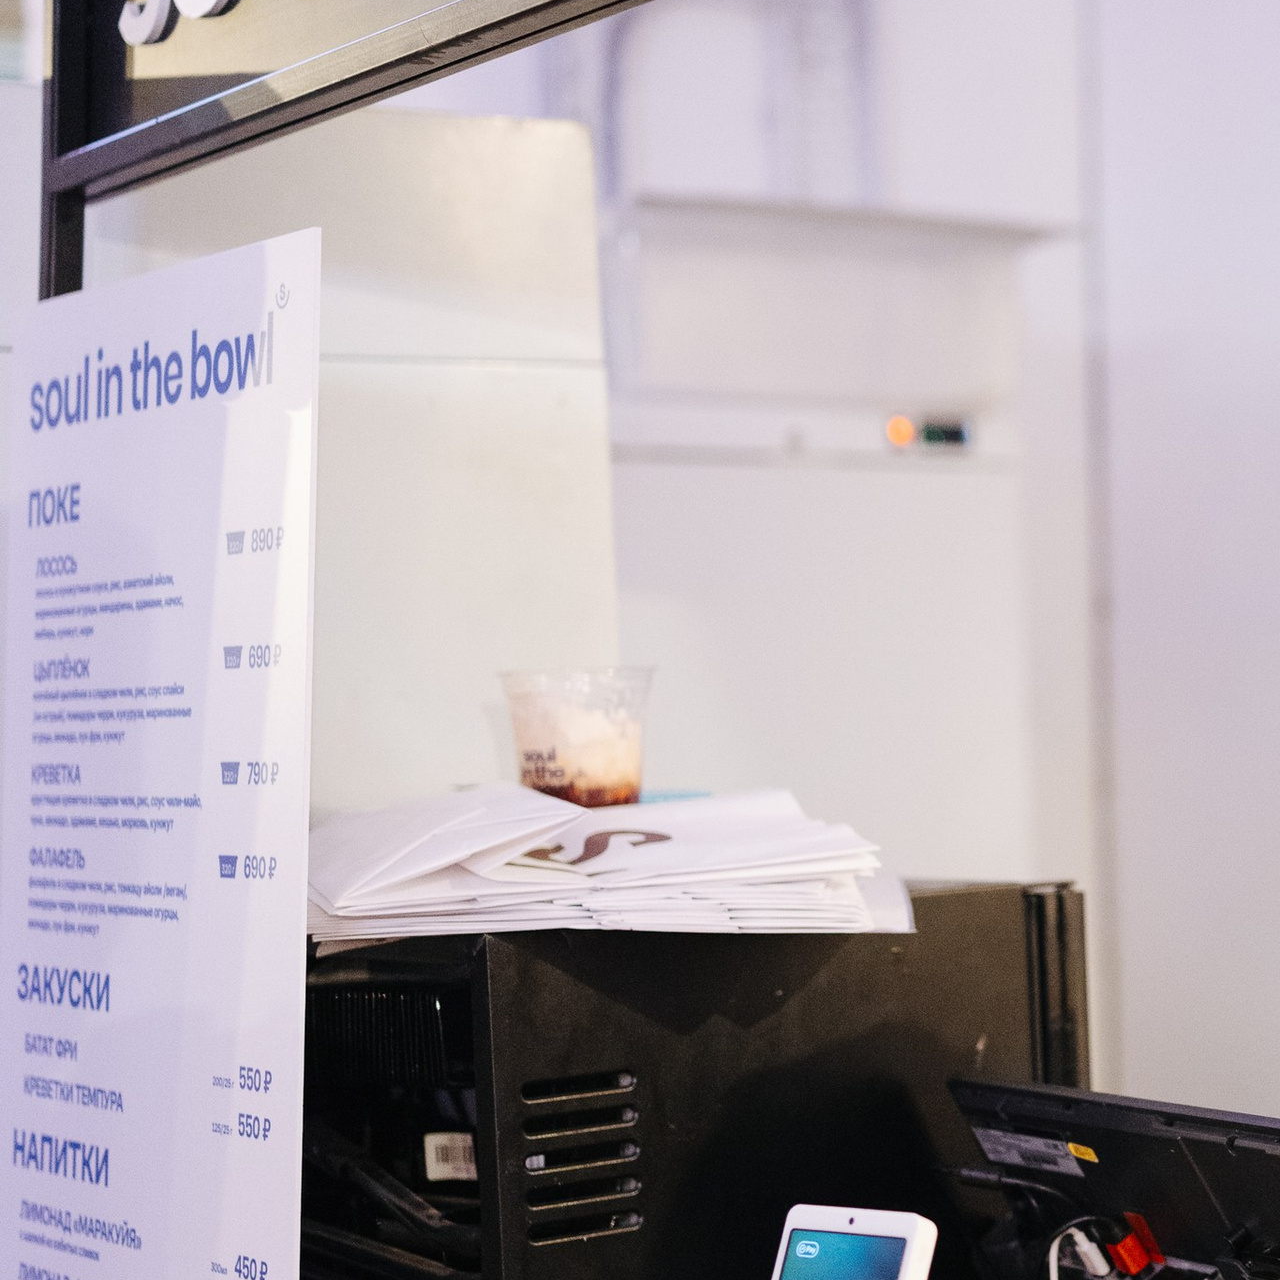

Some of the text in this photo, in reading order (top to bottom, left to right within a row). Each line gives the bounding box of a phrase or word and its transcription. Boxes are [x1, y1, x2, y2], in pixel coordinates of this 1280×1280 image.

[30, 311, 274, 432] soul in the bowl
[28, 483, 81, 528] ПОКЕ
[250, 528, 274, 552] 890
[35, 556, 78, 577] ЛОСОСЬ
[33, 654, 90, 682] ЦЫПЛЁНОК
[248, 645, 271, 669] 690
[31, 763, 81, 785] КРЕВЕТКА
[246, 761, 268, 785] 790
[270, 762, 279, 786] ₽
[29, 846, 85, 869] ФАЛАФЕЛЬ
[243, 854, 267, 879] 690
[268, 855, 277, 879] ₽
[17, 963, 110, 1013] ЗАКУСКИ
[24, 1033, 79, 1063] БАТАТ ФРИ
[23, 1074, 125, 1113] КРЕВЕТКИ ТЕМПУРА
[239, 1065, 261, 1092] 550
[263, 1070, 272, 1094] ₽
[238, 1113, 260, 1140] 550
[262, 1117, 271, 1141] ₽
[12, 1129, 109, 1188] НАПИТКИ
[19, 1199, 72, 1234] ЛИМОНАД
[72, 1213, 142, 1250] «МАРАКУЙЯ»
